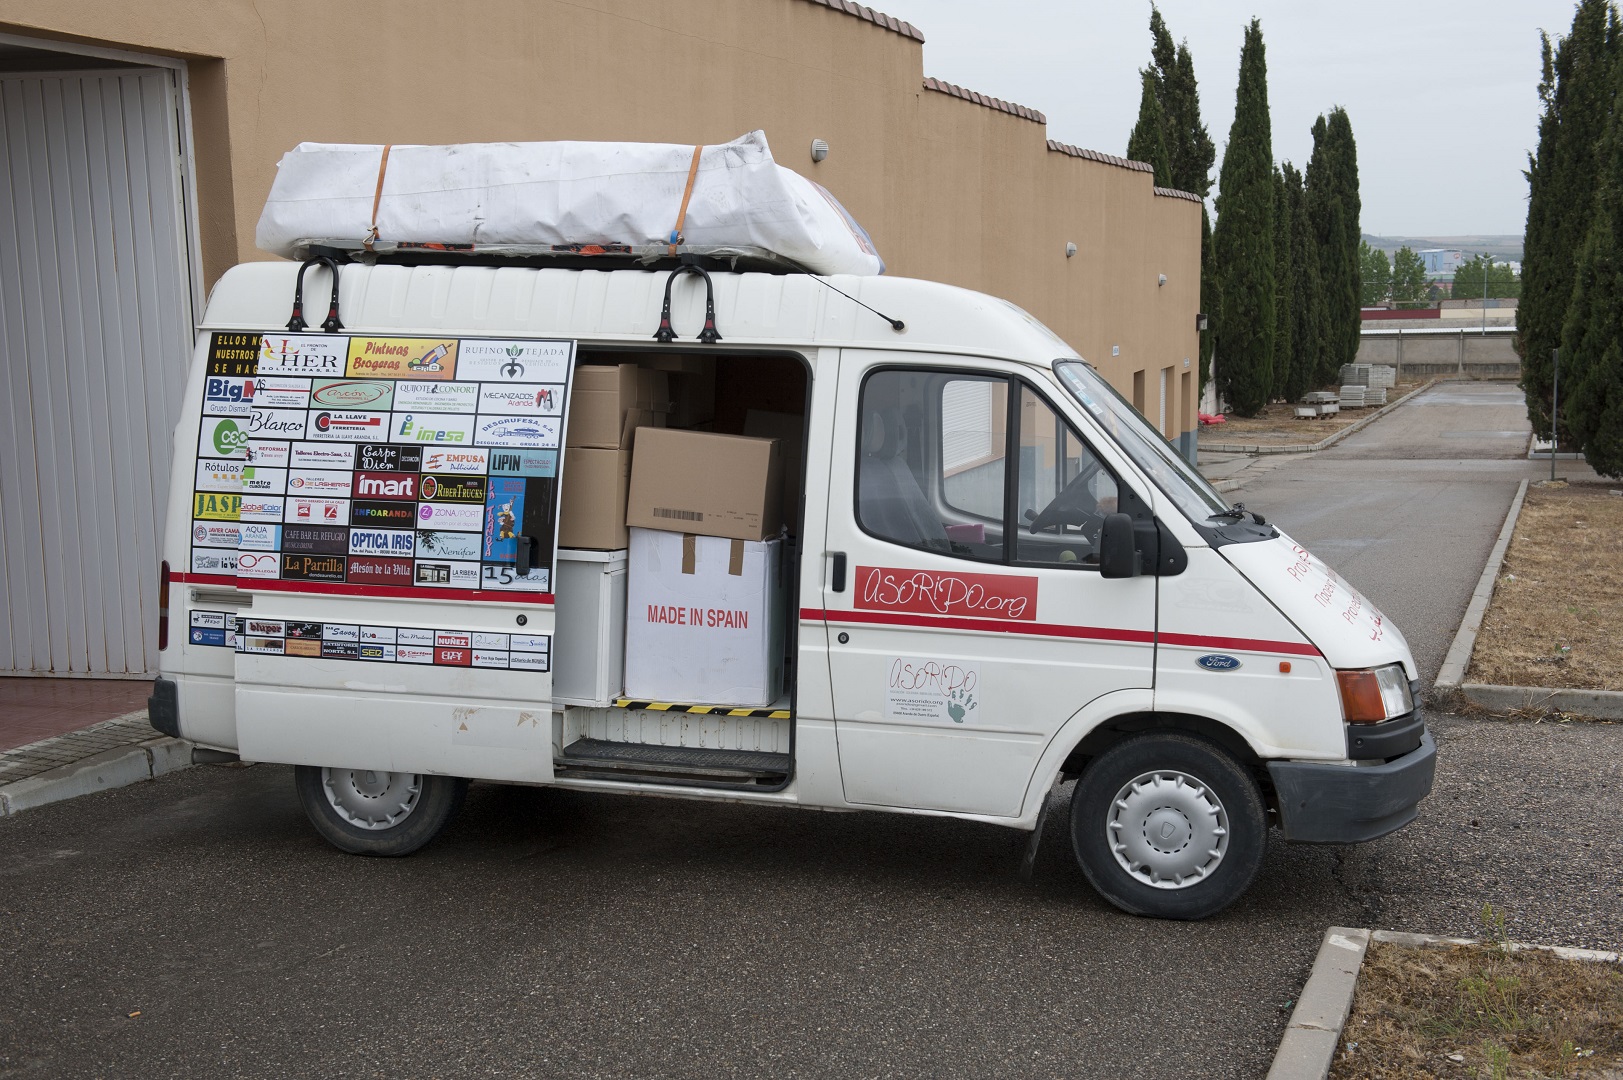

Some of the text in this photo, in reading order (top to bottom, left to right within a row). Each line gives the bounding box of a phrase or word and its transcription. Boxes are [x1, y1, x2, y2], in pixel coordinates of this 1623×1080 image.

[217, 335, 247, 346] ELLOS
[215, 350, 254, 360] NUESTROS
[364, 342, 409, 357] Pinturas
[466, 346, 564, 357] RUFINO TEJADA
[214, 363, 228, 373] SE
[353, 357, 400, 371] Brogeras
[400, 384, 476, 394] QUIJOTE CONFORT
[210, 404, 248, 413] Grupo Dismar
[249, 411, 304, 433] Blanco
[362, 445, 397, 463] Carpe
[446, 454, 485, 463] EMPUSA
[205, 462, 239, 473] Rótulos
[362, 458, 394, 470] Diem
[492, 454, 521, 472] LIPIN
[354, 508, 413, 518] INFOARANDA
[246, 526, 268, 534] AQUA
[300, 531, 312, 540] BAR
[313, 532, 320, 540] EL
[321, 532, 346, 542] REFUGIO
[352, 532, 413, 550] OPTICA IRIS
[285, 557, 343, 575] La Parrilla
[350, 562, 411, 576] Mesón de la Villa
[484, 566, 514, 585] 15
[648, 604, 748, 629] MADE IN SPAIN
[332, 628, 356, 638] Savoy
[438, 636, 466, 646] NUÑEZ
[362, 649, 383, 657] SER
[1206, 656, 1232, 668] Ford
